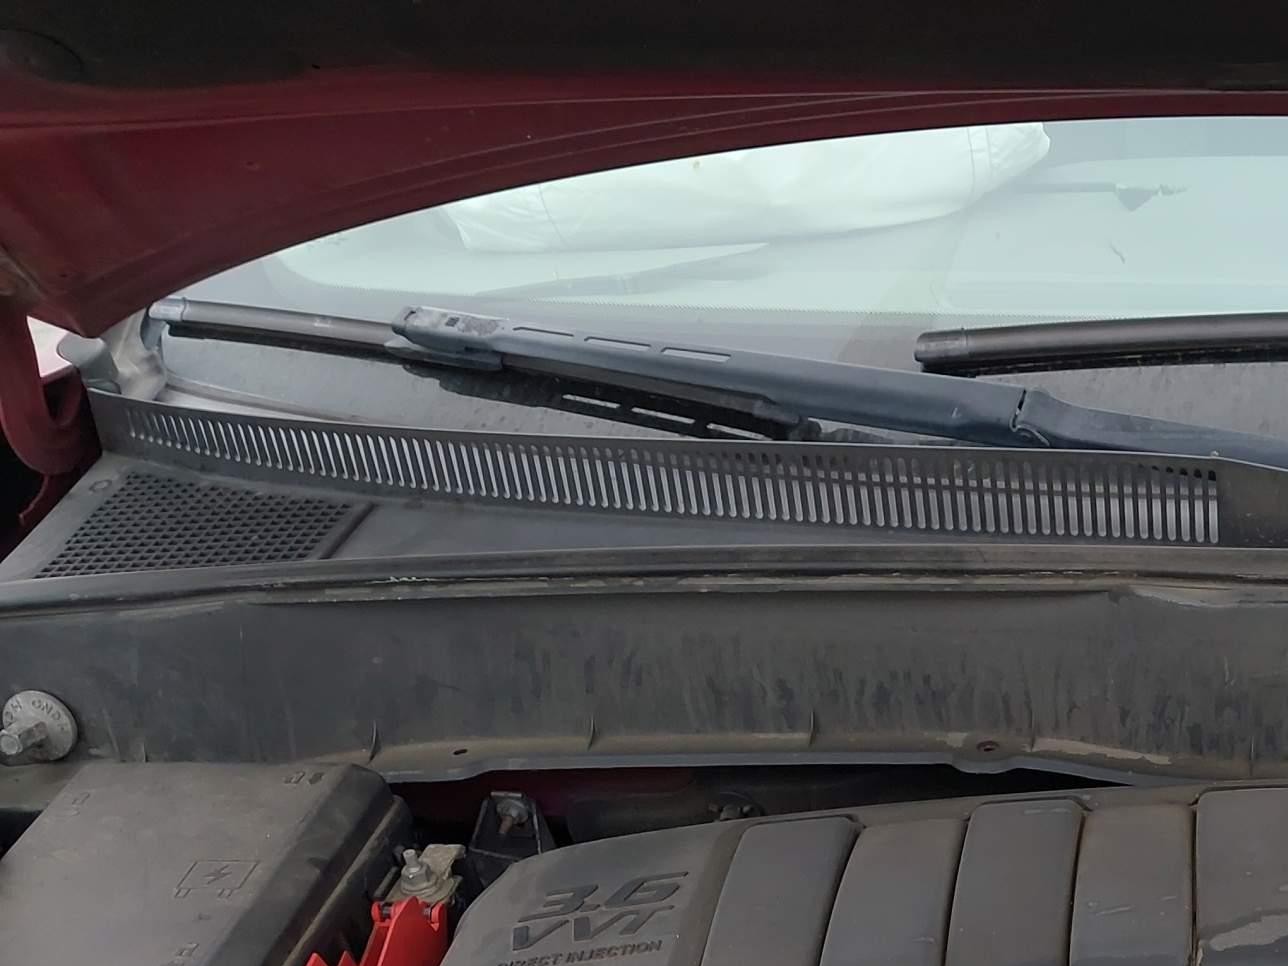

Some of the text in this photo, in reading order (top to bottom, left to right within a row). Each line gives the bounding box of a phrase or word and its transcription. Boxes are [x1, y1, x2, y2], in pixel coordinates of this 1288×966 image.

[519, 871, 690, 922] 3.6
[513, 904, 676, 951] VVT
[565, 939, 663, 965] INJECTION
